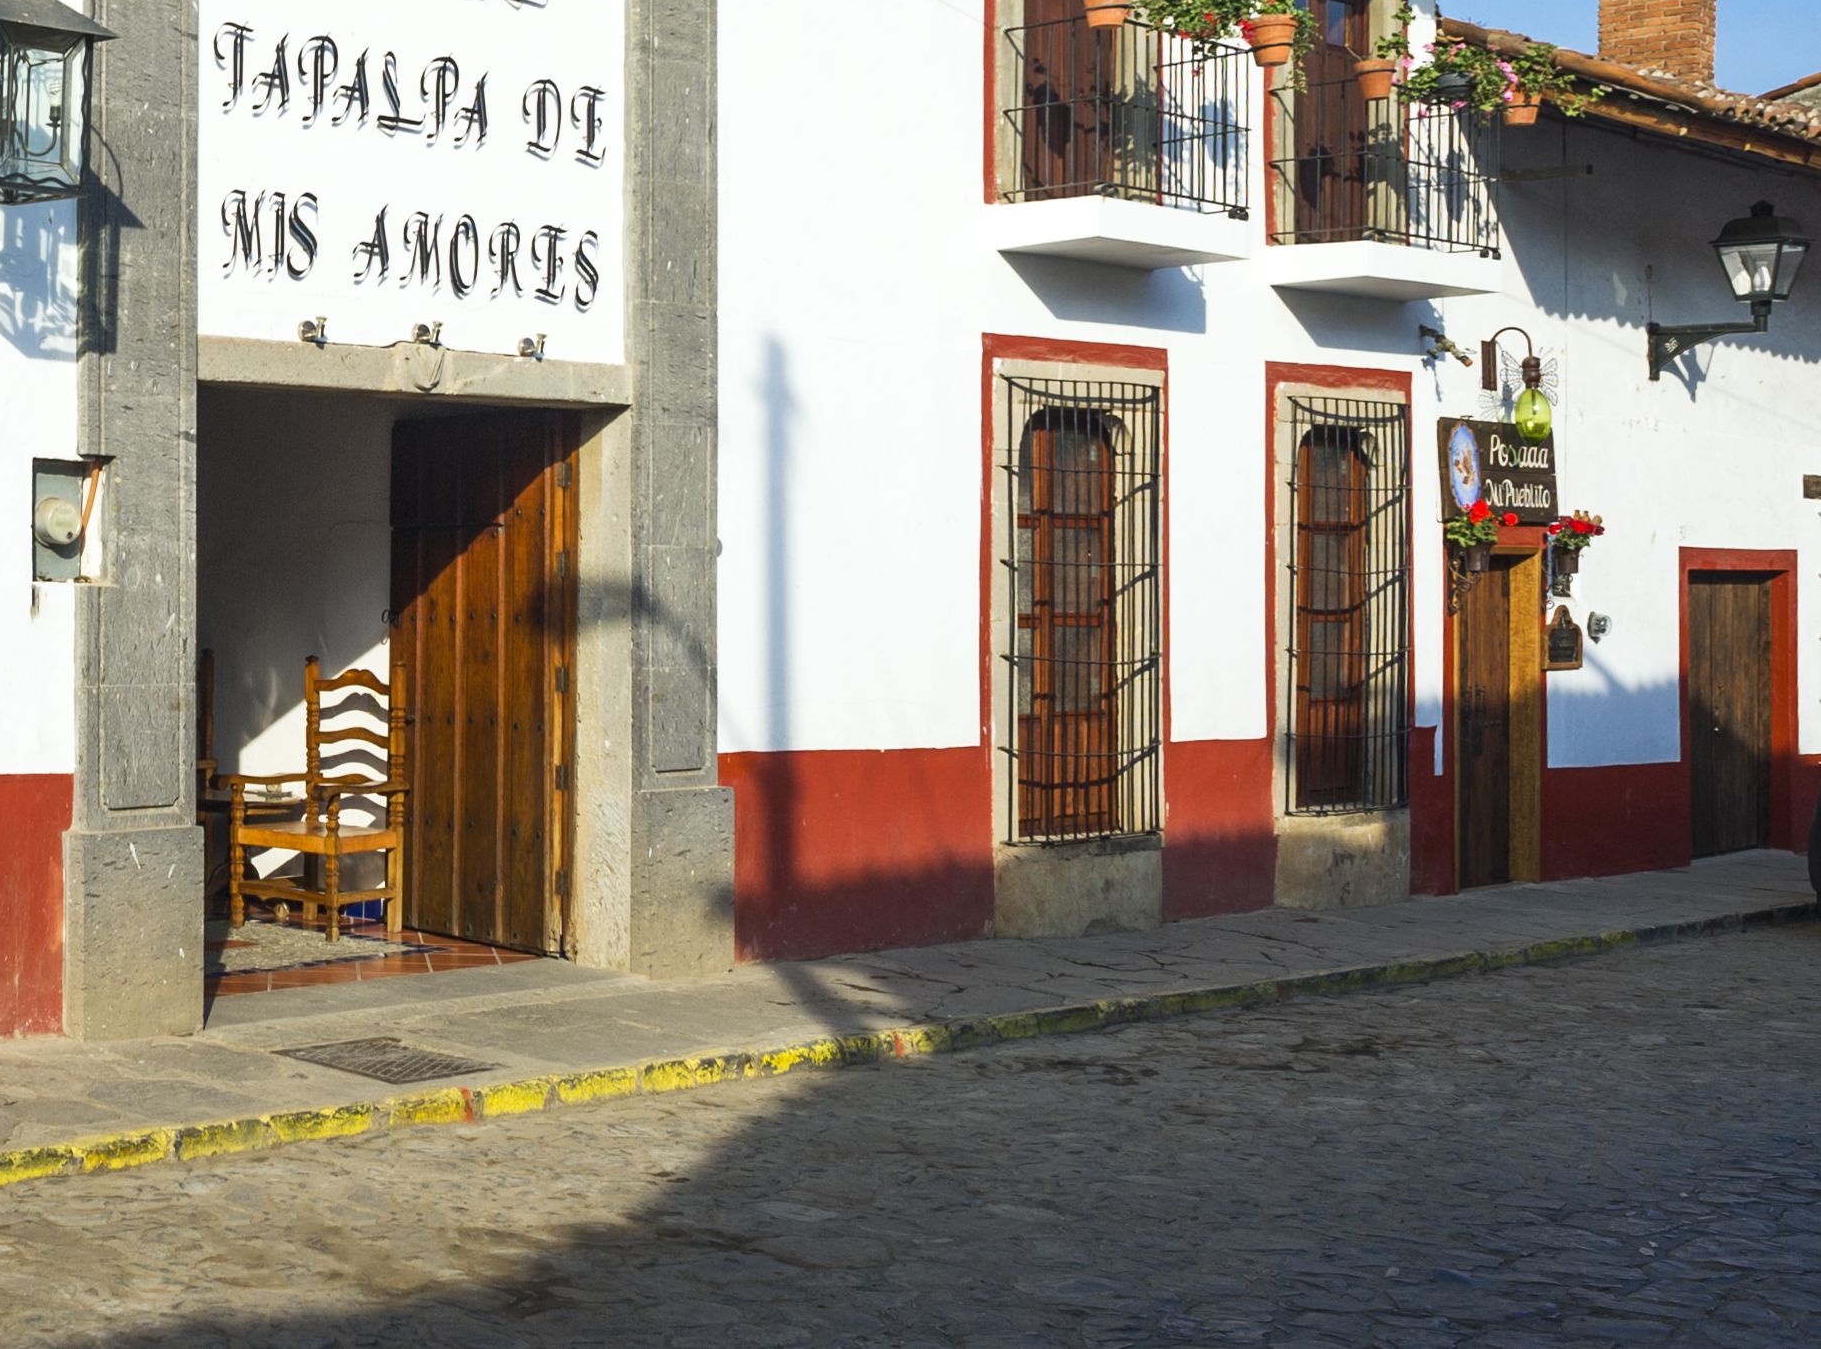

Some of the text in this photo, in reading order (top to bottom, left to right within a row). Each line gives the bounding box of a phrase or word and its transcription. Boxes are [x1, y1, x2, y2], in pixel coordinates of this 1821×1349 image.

[212, 20, 608, 162] TAPALPA DE
[220, 188, 600, 307] MIS AMORES
[1501, 478, 1551, 509] Pueblito
